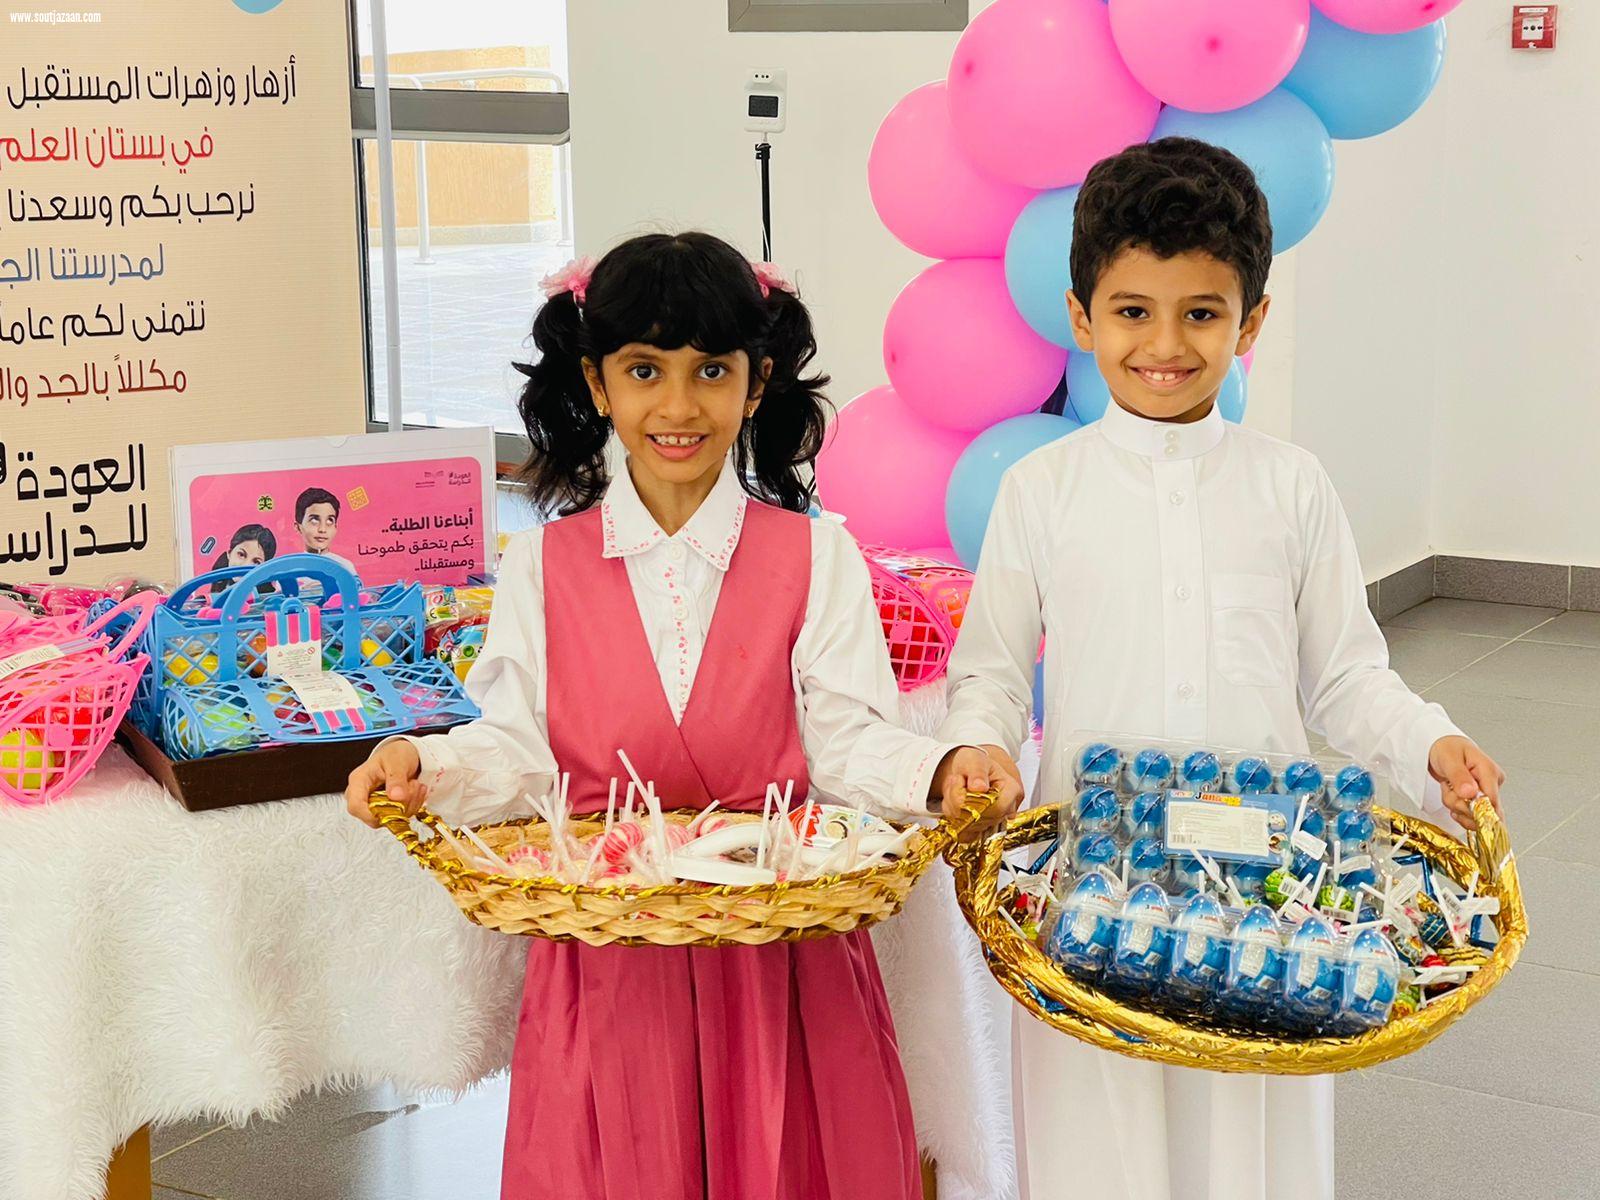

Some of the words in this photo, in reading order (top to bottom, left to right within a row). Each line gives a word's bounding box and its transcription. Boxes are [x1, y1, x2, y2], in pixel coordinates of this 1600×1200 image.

[6, 64, 140, 110] المستقبل
[146, 65, 237, 107] وزهرات
[243, 54, 296, 107] أزهار
[0, 126, 78, 171] العلم
[85, 126, 166, 169] بستان
[170, 126, 214, 174] في
[7, 188, 113, 228] وسعدنا
[120, 184, 182, 227] بكم
[186, 182, 255, 224] نرحب
[49, 243, 165, 286] لمدرستنا
[62, 302, 125, 347] لكم
[131, 299, 207, 342] نتمنى
[36, 362, 111, 403] بالجد
[357, 540, 406, 557] طموحنا
[408, 538, 448, 555] يتحقق
[450, 534, 475, 553] بكم
